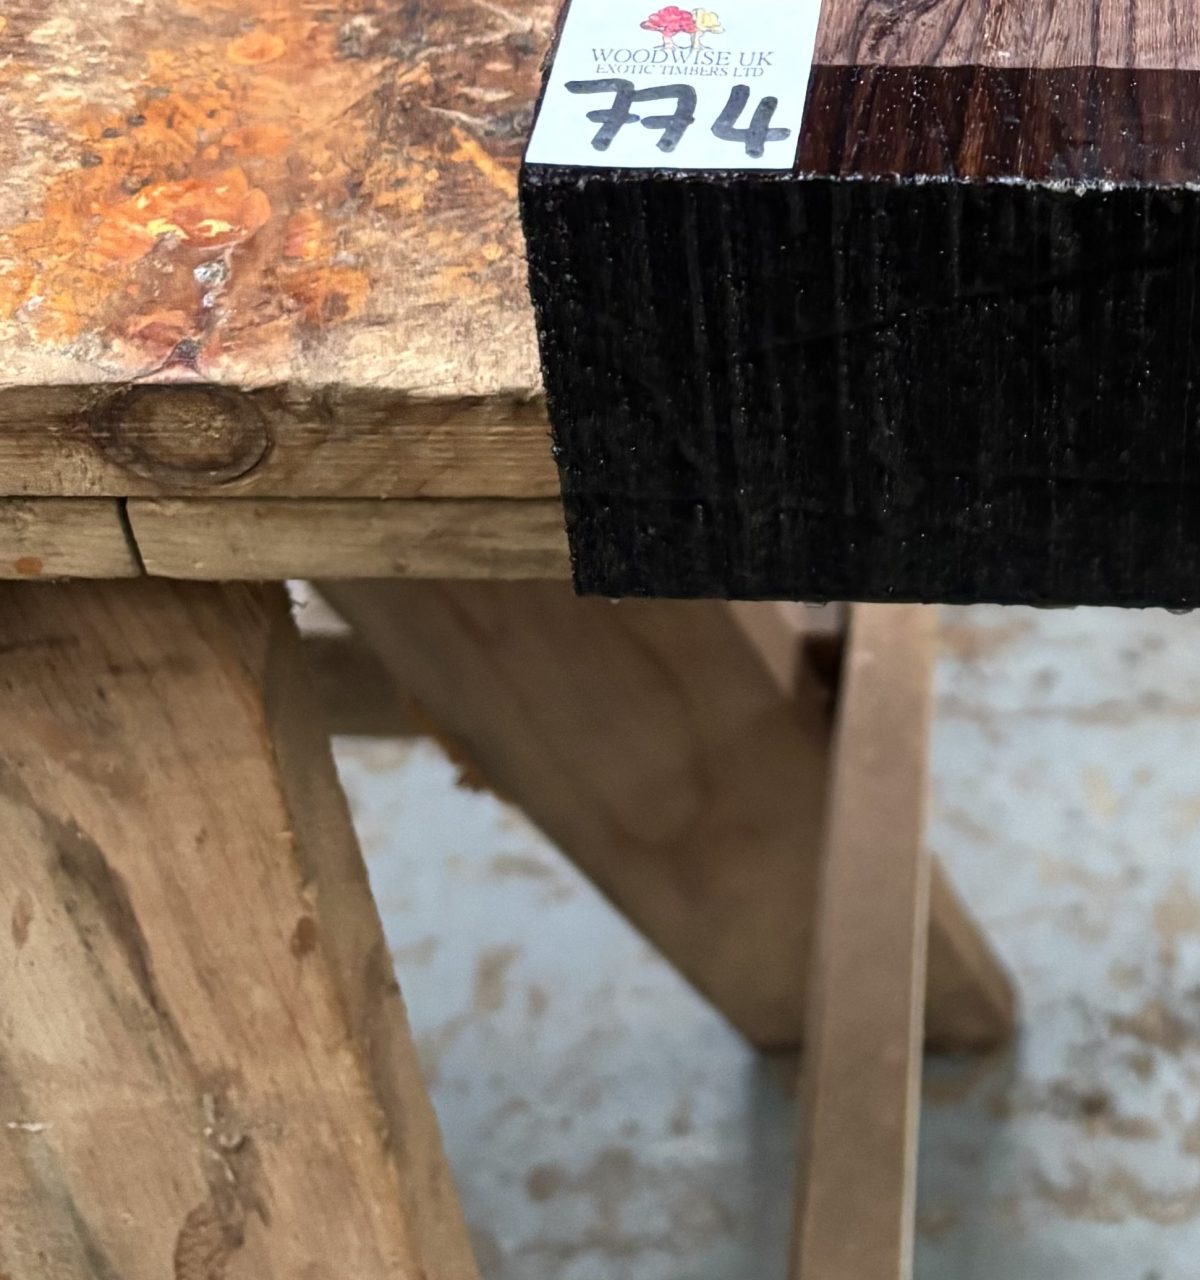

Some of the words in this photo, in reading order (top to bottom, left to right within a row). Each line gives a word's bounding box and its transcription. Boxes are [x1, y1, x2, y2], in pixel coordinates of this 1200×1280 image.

[592, 48, 731, 66] WOODWISE
[739, 51, 774, 66] UK
[596, 64, 654, 74] EXOTIC
[659, 65, 728, 76] TIMBERS
[733, 67, 764, 77] LTD
[564, 78, 791, 159] 774
